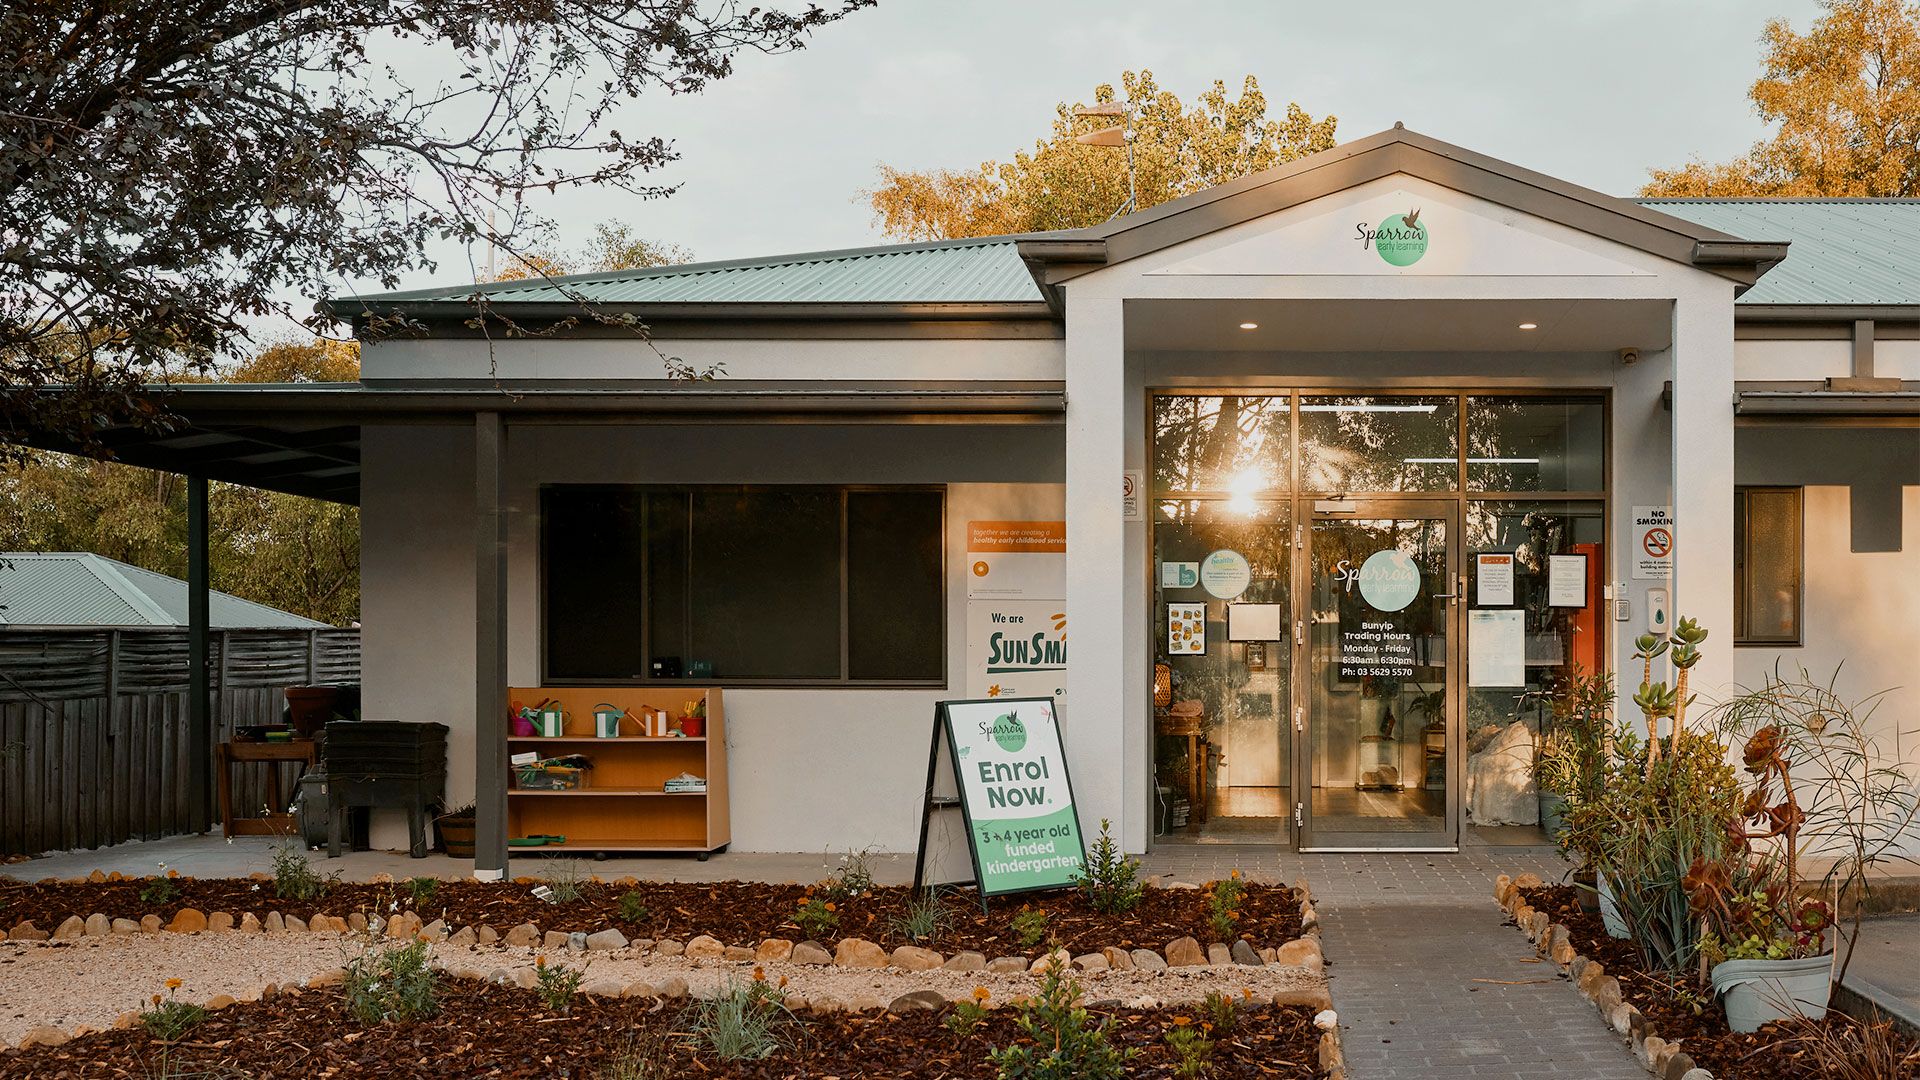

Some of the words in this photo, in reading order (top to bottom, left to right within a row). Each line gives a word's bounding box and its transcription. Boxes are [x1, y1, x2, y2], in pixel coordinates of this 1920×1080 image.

[1354, 222, 1424, 250] Sparrow
[1378, 241, 1395, 253] early
[1396, 241, 1424, 254] learning
[1651, 510, 1665, 518] NO
[973, 529, 998, 537] together
[1021, 529, 1045, 537] creating
[973, 537, 998, 545] healthy
[999, 537, 1015, 545] early
[1334, 560, 1415, 593] Sparrow
[1362, 583, 1384, 593] early
[1384, 583, 1415, 593] learning
[992, 612, 1006, 624] We
[1009, 615, 1024, 623] are
[1361, 621, 1394, 631] Bunyip
[1344, 631, 1381, 641] Trading
[1383, 632, 1410, 640] Hours
[1343, 644, 1378, 654] Monday
[1385, 644, 1411, 655] Friday
[1342, 656, 1374, 664] 6:30am
[1380, 656, 1412, 666] 6:30pm
[1342, 667, 1356, 676] Ph:
[1357, 668, 1368, 676] 03
[1370, 668, 1391, 676] 5629
[1392, 668, 1413, 676] 5570
[979, 721, 1024, 742] Sparrow
[978, 756, 1049, 783] Enrol
[982, 832, 991, 843] 3
[1003, 830, 1012, 841] 4
[1014, 828, 1046, 843] year
[1049, 824, 1071, 837] old
[1005, 840, 1055, 857] funded
[986, 855, 1079, 875] kindergarten
